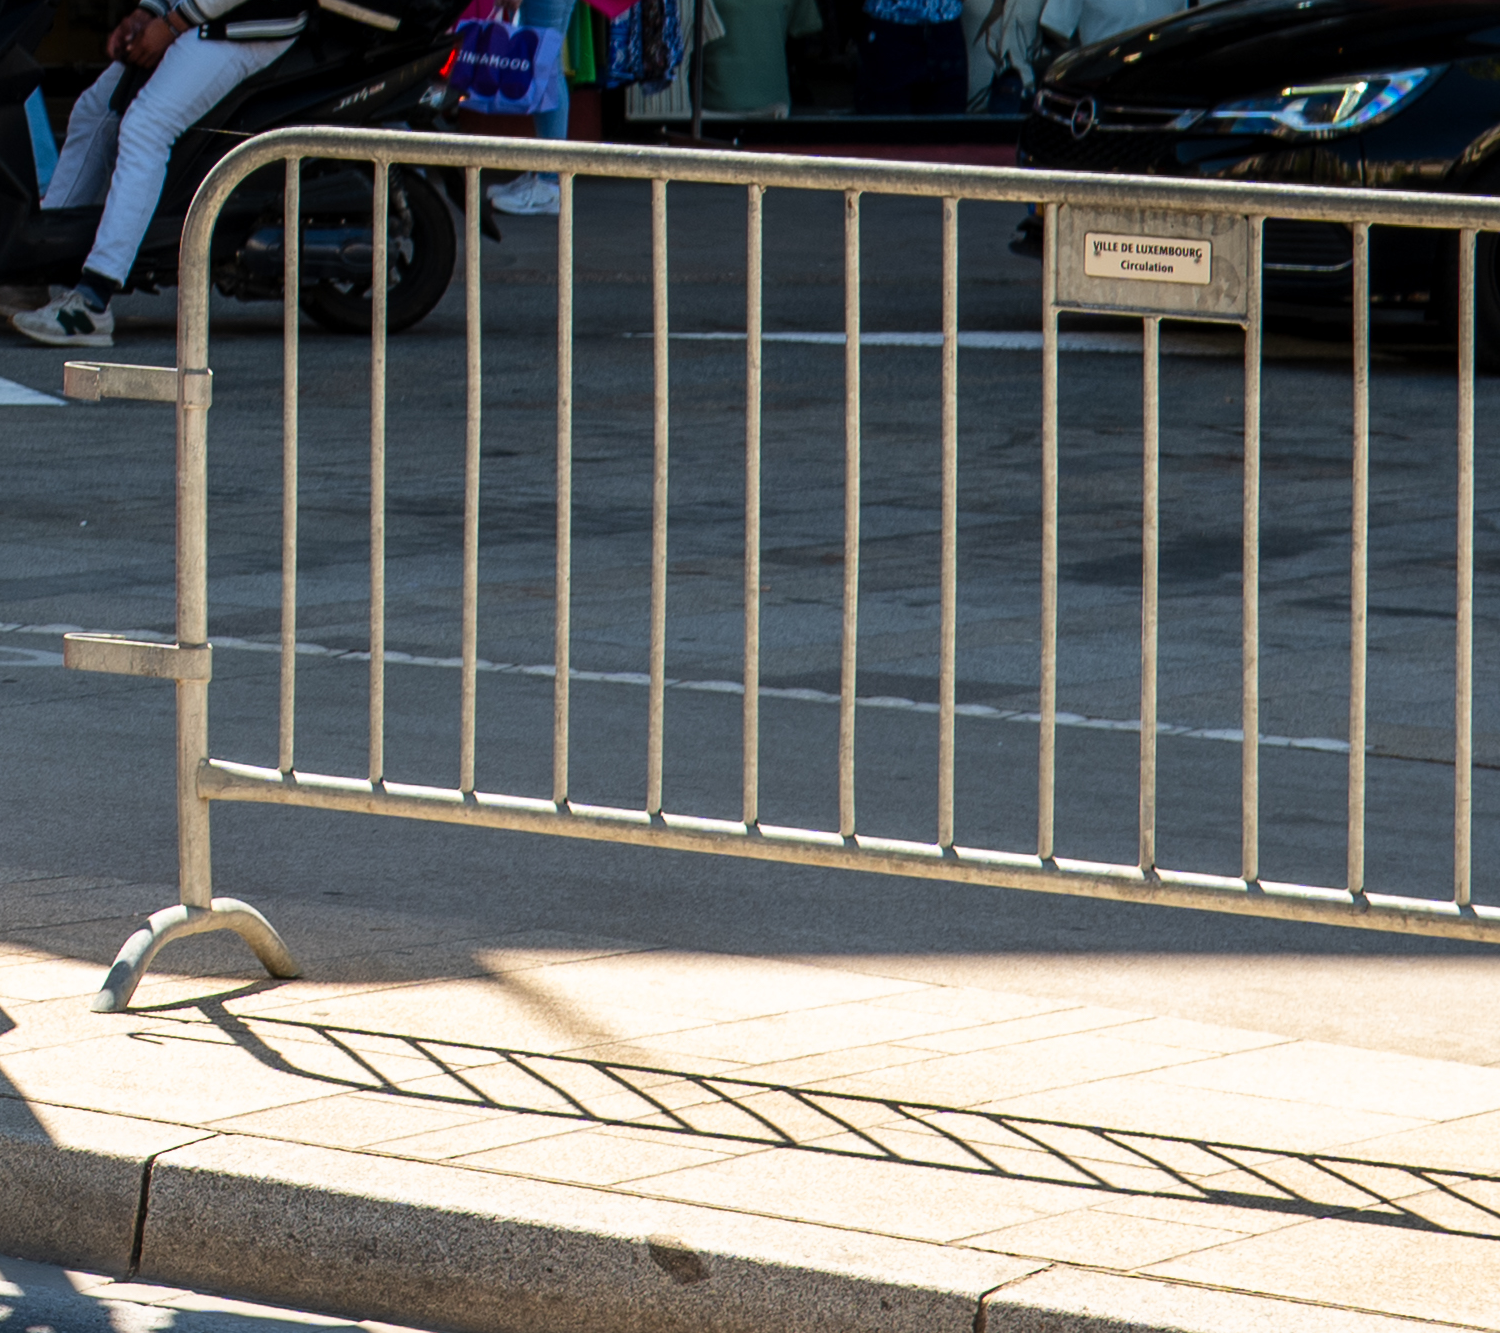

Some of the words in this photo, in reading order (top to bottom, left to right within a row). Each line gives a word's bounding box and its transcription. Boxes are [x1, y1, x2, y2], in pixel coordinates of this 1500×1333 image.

[1093, 240, 1117, 253] VILLE
[1120, 242, 1133, 253] DE
[1135, 243, 1202, 259] LUXEMBOURG
[1120, 259, 1173, 273] Circulation
